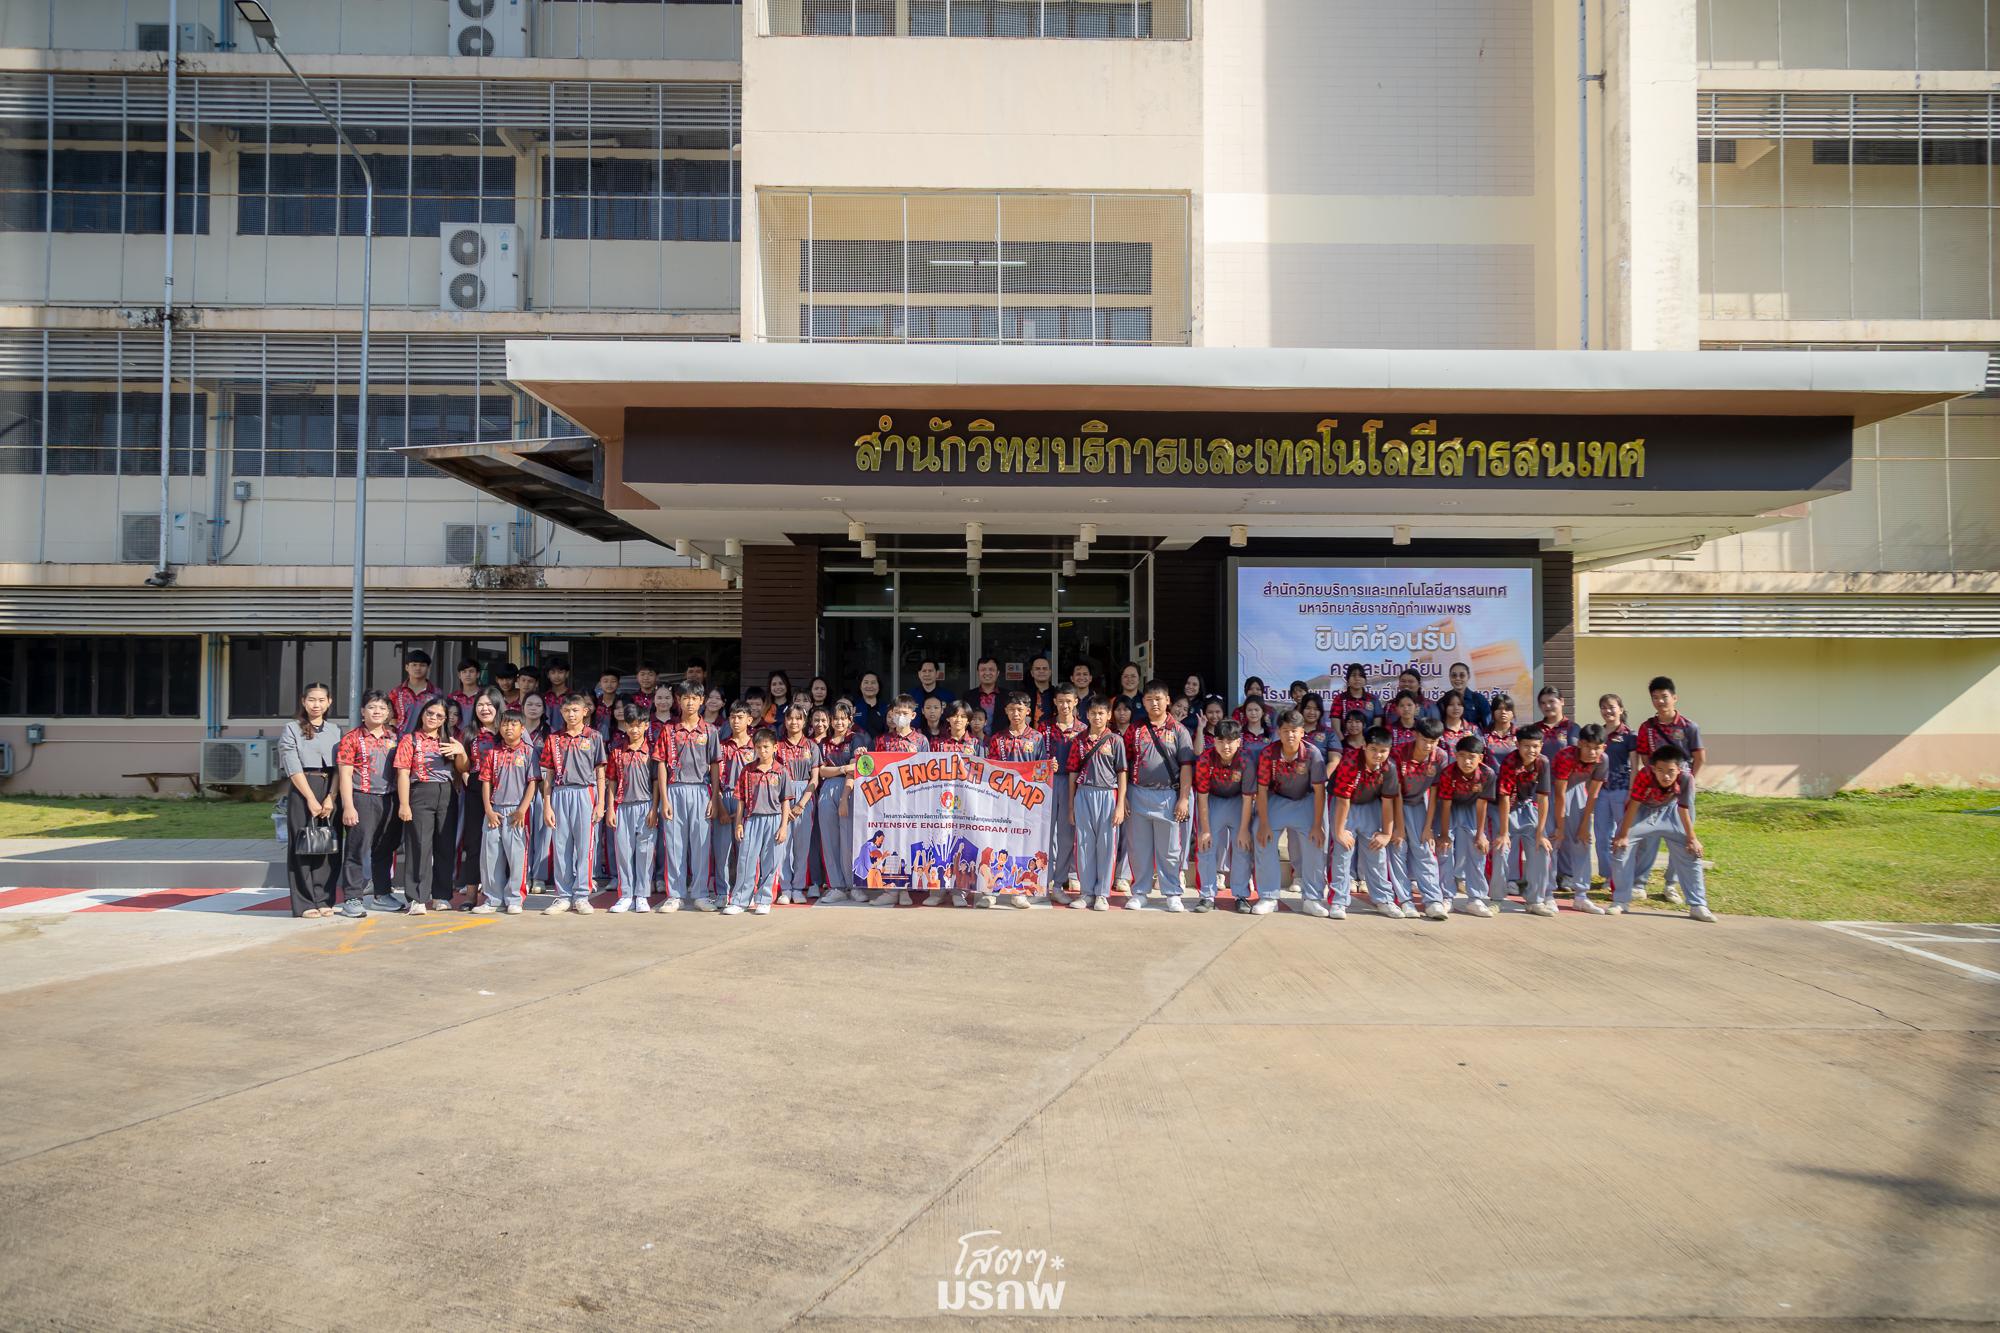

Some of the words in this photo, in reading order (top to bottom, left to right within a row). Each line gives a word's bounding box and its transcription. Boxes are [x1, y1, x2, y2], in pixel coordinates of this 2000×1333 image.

[854, 414, 1646, 478] สำนักวิทยบริการและเทคโนโลยีสารสนเทศ
[1263, 581, 1508, 597] สำนักวิทยบริการและเทคโนโลยีสารสนเทศ
[1299, 601, 1472, 616] มหาวิทยาลัยราชภัฏกำแพงเพชร
[1315, 624, 1457, 651] ยินดีต้อนรับ
[988, 770, 1046, 810] CAMP
[868, 821, 917, 829] INTENSIVE
[920, 822, 958, 830] ENGLISH
[959, 823, 1008, 834] PROGRAM
[1010, 827, 1032, 836] (IEP)
